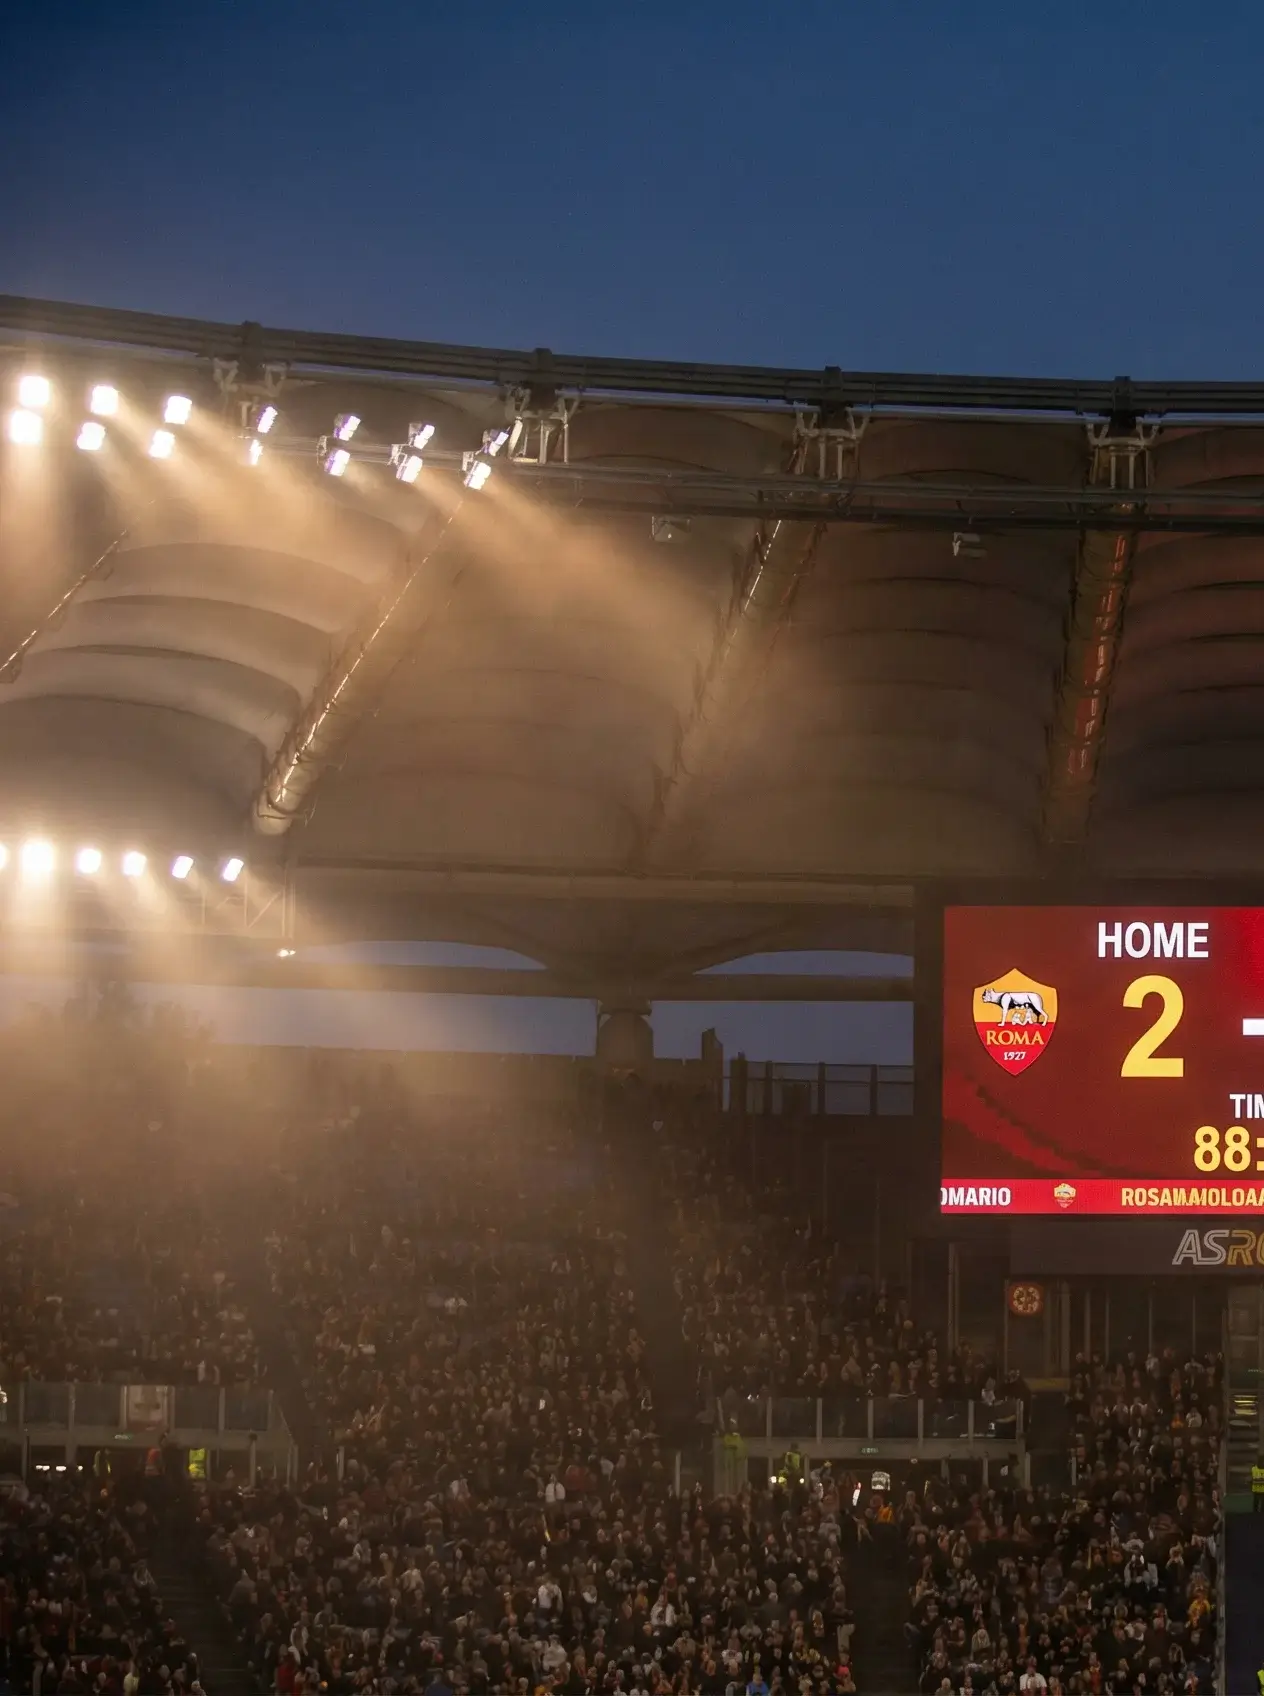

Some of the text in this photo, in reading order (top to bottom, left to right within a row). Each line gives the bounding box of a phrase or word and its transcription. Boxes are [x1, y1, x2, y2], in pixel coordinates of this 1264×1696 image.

[1098, 921, 1209, 959] HOME
[986, 1030, 1045, 1046] ROMA
[1121, 974, 1184, 1078] 2
